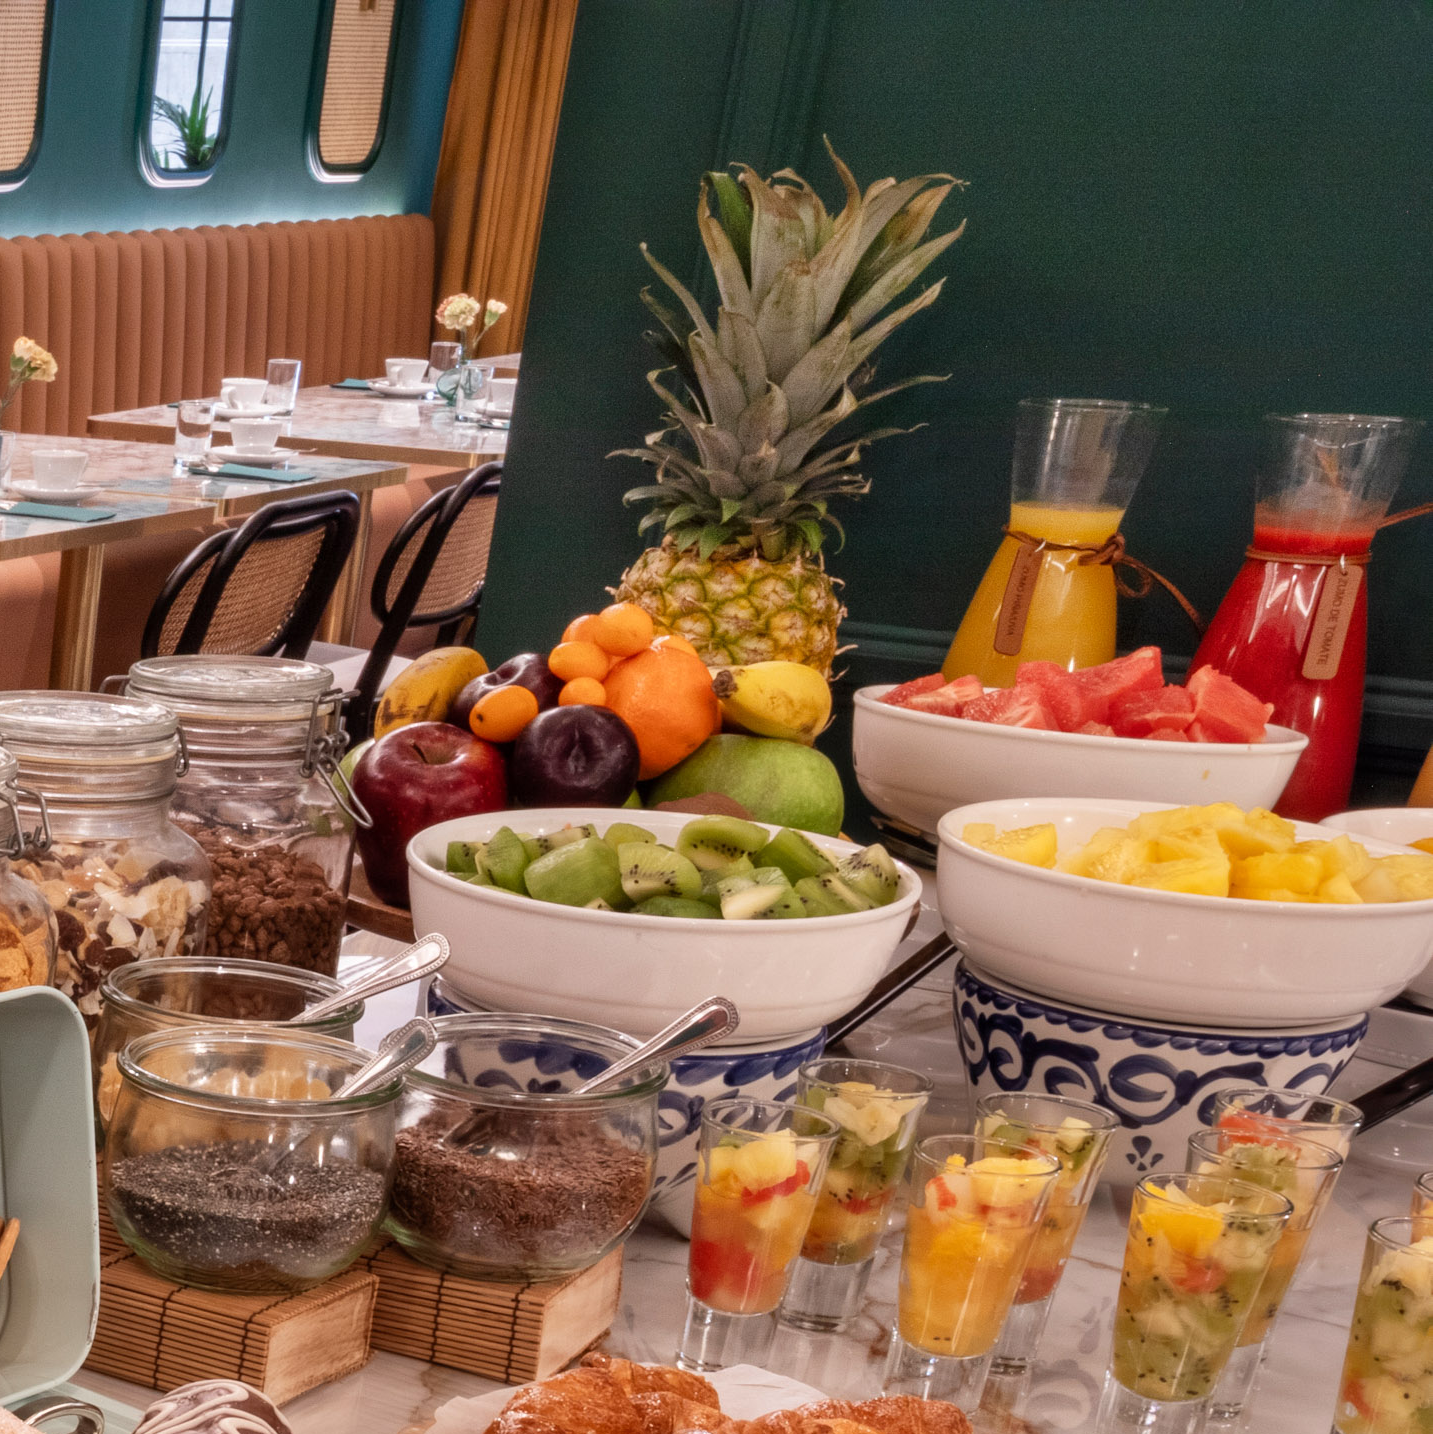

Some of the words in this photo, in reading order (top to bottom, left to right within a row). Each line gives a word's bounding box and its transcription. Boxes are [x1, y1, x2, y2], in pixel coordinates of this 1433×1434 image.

[1332, 577, 1349, 607] ZUMO
[1327, 608, 1341, 623] DE
[1316, 626, 1337, 666] TOMATE
